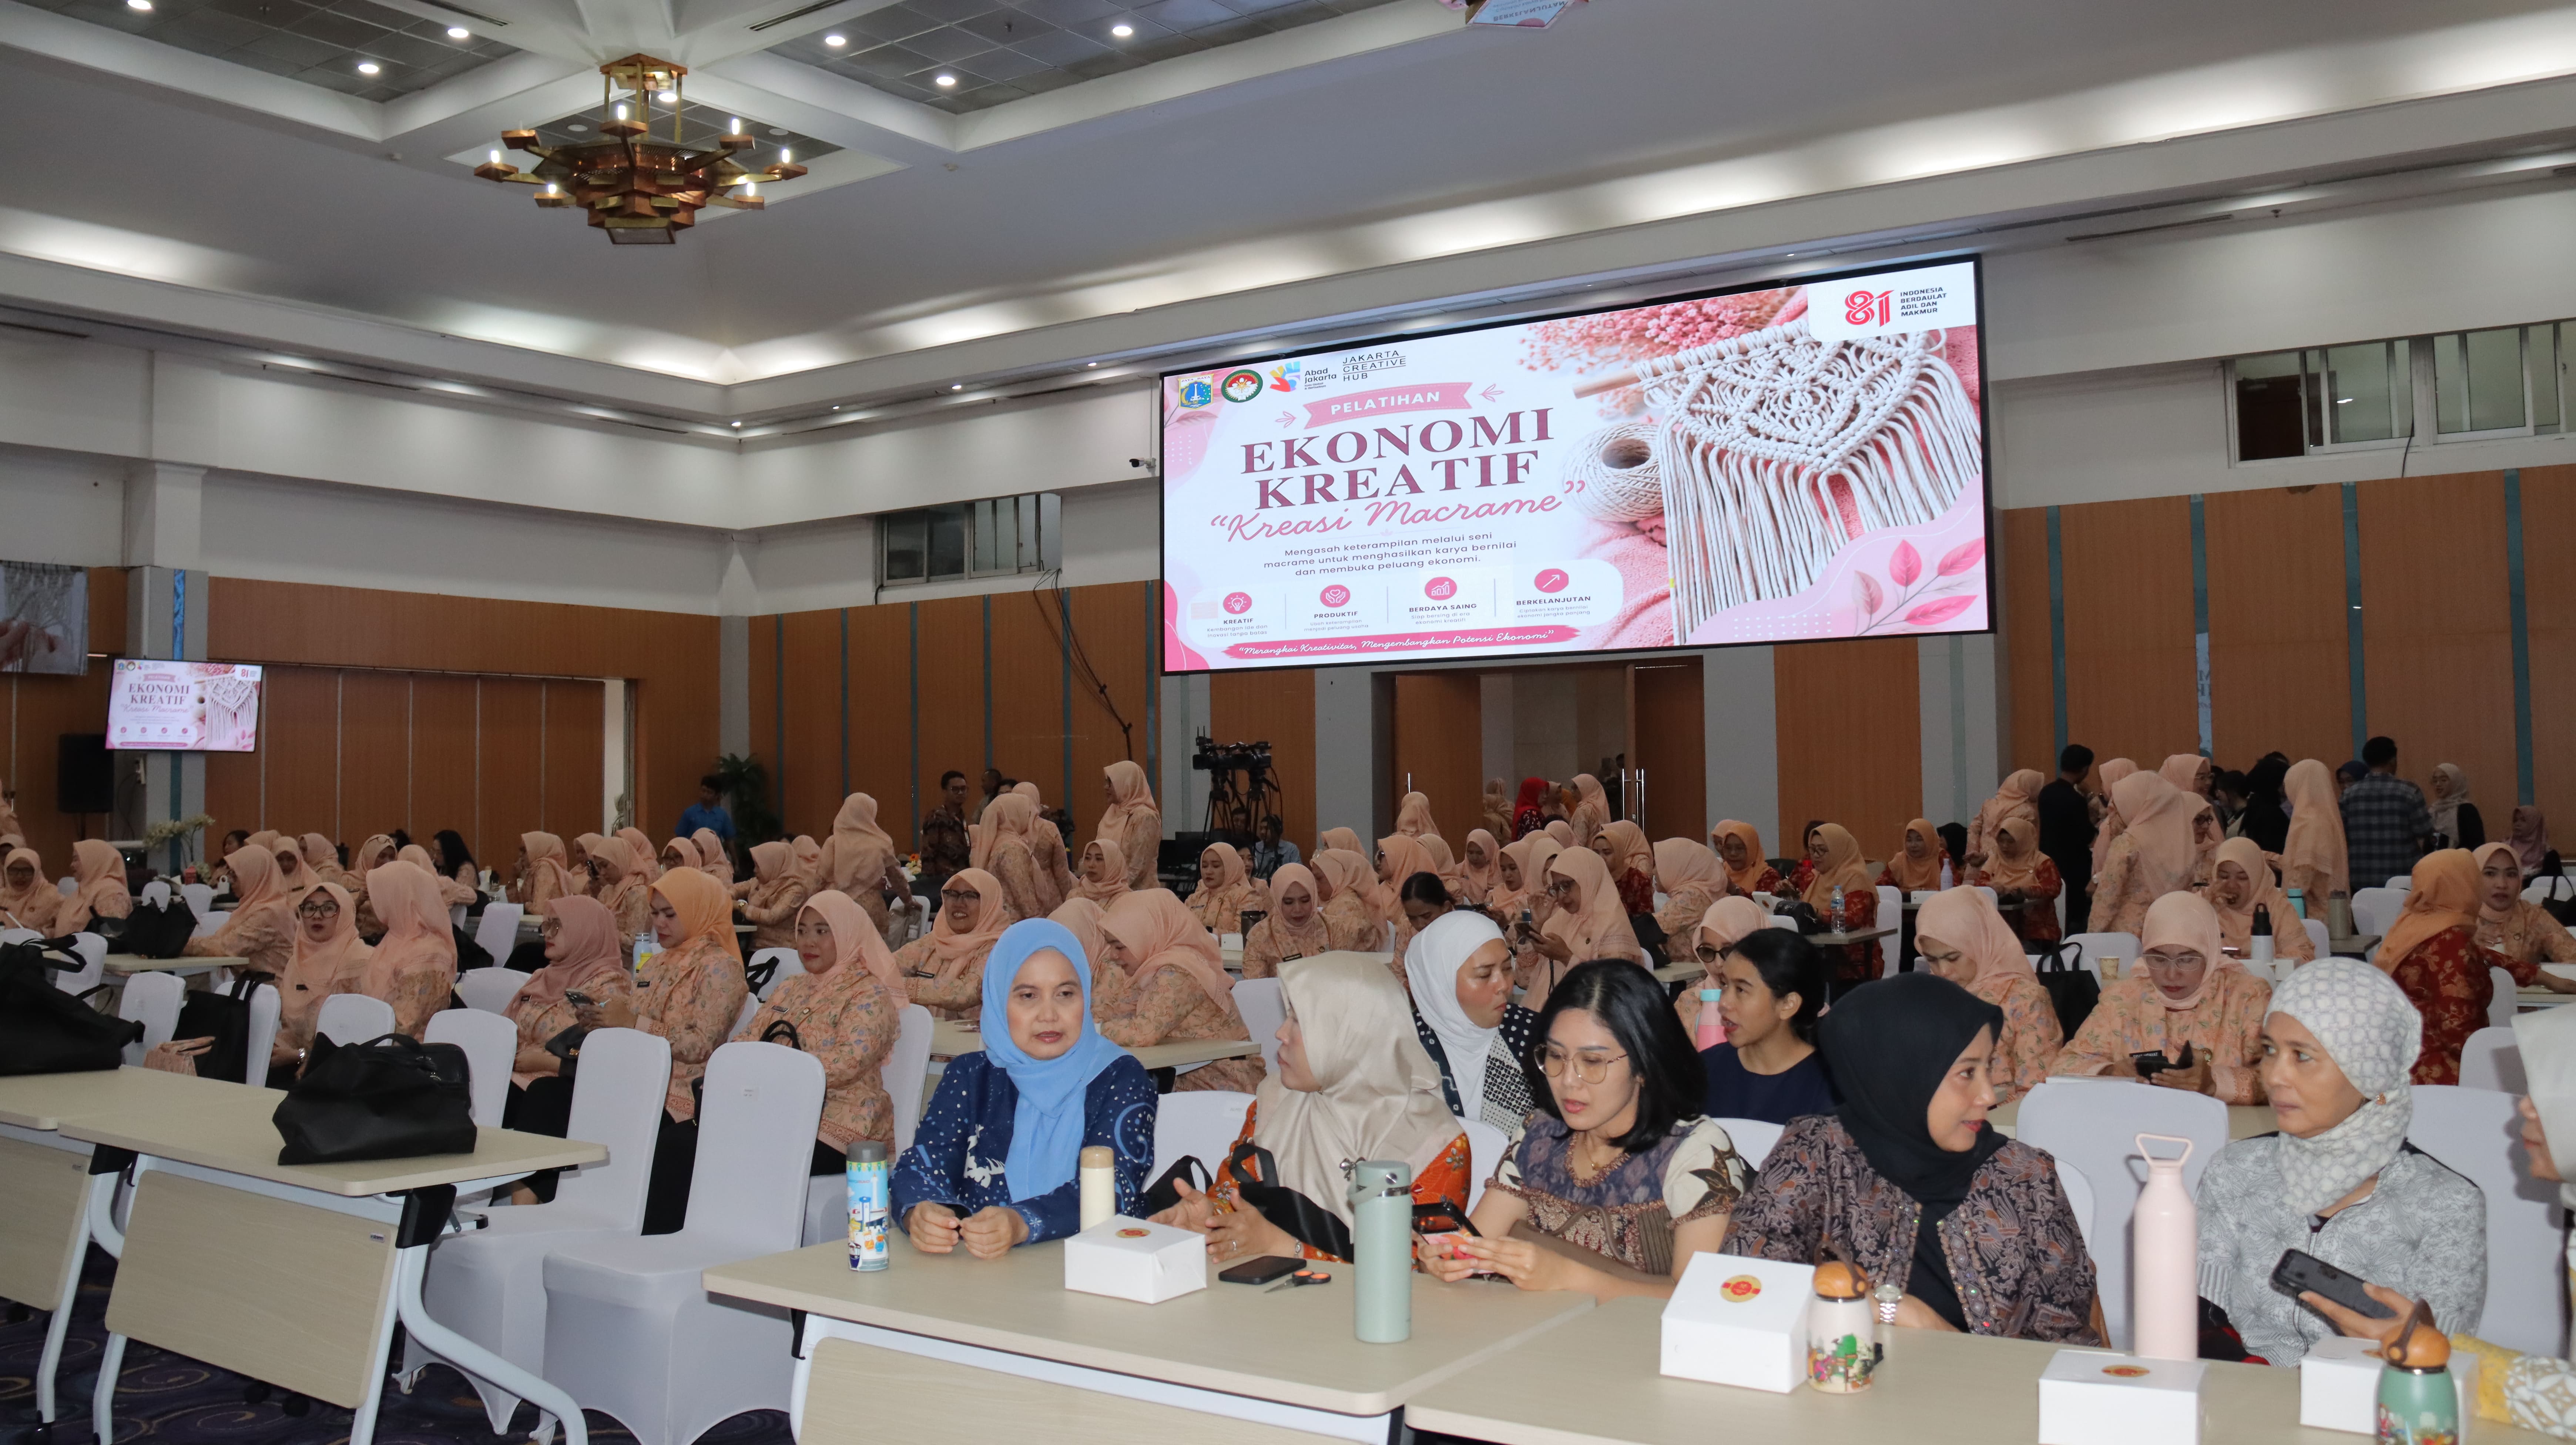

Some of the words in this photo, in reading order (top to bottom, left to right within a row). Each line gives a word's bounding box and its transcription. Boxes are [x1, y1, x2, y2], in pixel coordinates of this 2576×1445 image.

[1900, 287, 1943, 296] INDONESIA
[1901, 293, 1947, 303] BERDAULAT
[1845, 290, 1895, 327] 81
[1901, 308, 1938, 316] MAKMUR
[1343, 350, 1399, 364] JAKARTA
[1305, 368, 1328, 376] Abad
[1343, 358, 1406, 372] CREATIVE
[1305, 373, 1336, 383] Jakarta
[1344, 373, 1368, 382] HUB
[1331, 391, 1440, 415] PELATIHAN
[1240, 408, 1554, 474] EKONOMI
[1255, 450, 1539, 510] KREATIF
[1285, 546, 1340, 557] Mengasah
[1344, 539, 1418, 551] keterampilan
[1422, 535, 1465, 544] melalui
[1469, 532, 1492, 540] seni
[1264, 559, 1315, 568] macrame
[1319, 555, 1349, 563] untuk
[1352, 548, 1432, 561] menghasilkan
[1436, 544, 1468, 556] karya
[1472, 541, 1516, 551] bernilai
[1319, 563, 1374, 574] membuka
[1378, 559, 1424, 571] peluang
[1428, 556, 1481, 566] ekonomi.
[1516, 596, 1590, 605] BERKELANJUTAN
[1300, 643, 1357, 652] Kreativitas,
[1361, 637, 1451, 649] Mengembangkan
[1453, 635, 1494, 644] Potensi
[129, 683, 189, 694] EKONOMI
[131, 694, 187, 705] KREATIF
